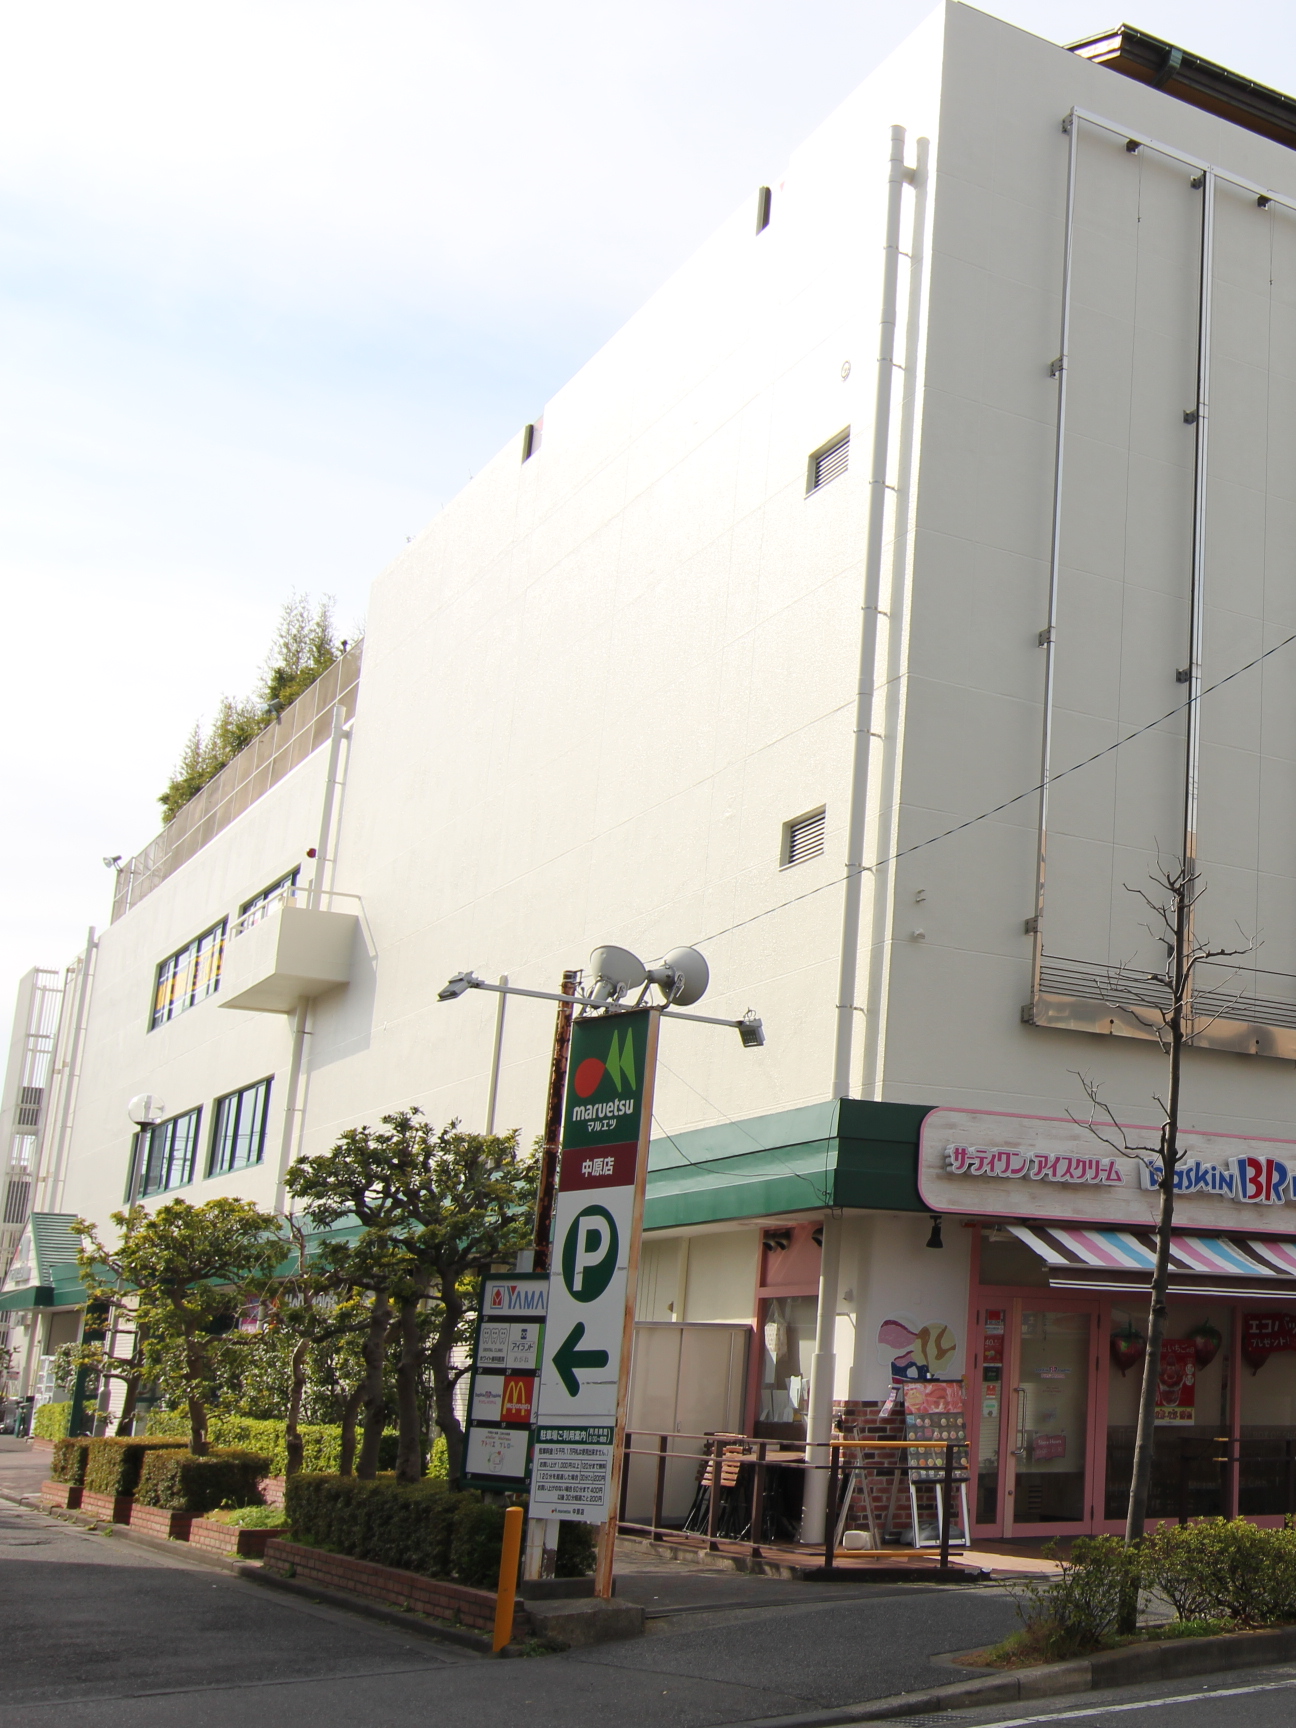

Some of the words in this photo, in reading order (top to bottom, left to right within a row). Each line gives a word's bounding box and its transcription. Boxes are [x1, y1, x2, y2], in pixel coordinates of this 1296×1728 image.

[573, 1098, 634, 1121] maruetsu
[587, 1119, 616, 1132] マルエツ
[582, 1157, 615, 1177] 中原店
[952, 1147, 1027, 1174] サーティワン
[1031, 1153, 1123, 1183] アイスクリーム
[573, 1215, 611, 1291] P
[507, 1285, 547, 1309] YAMA
[540, 1430, 587, 1441] 駐車場ご利用案内
